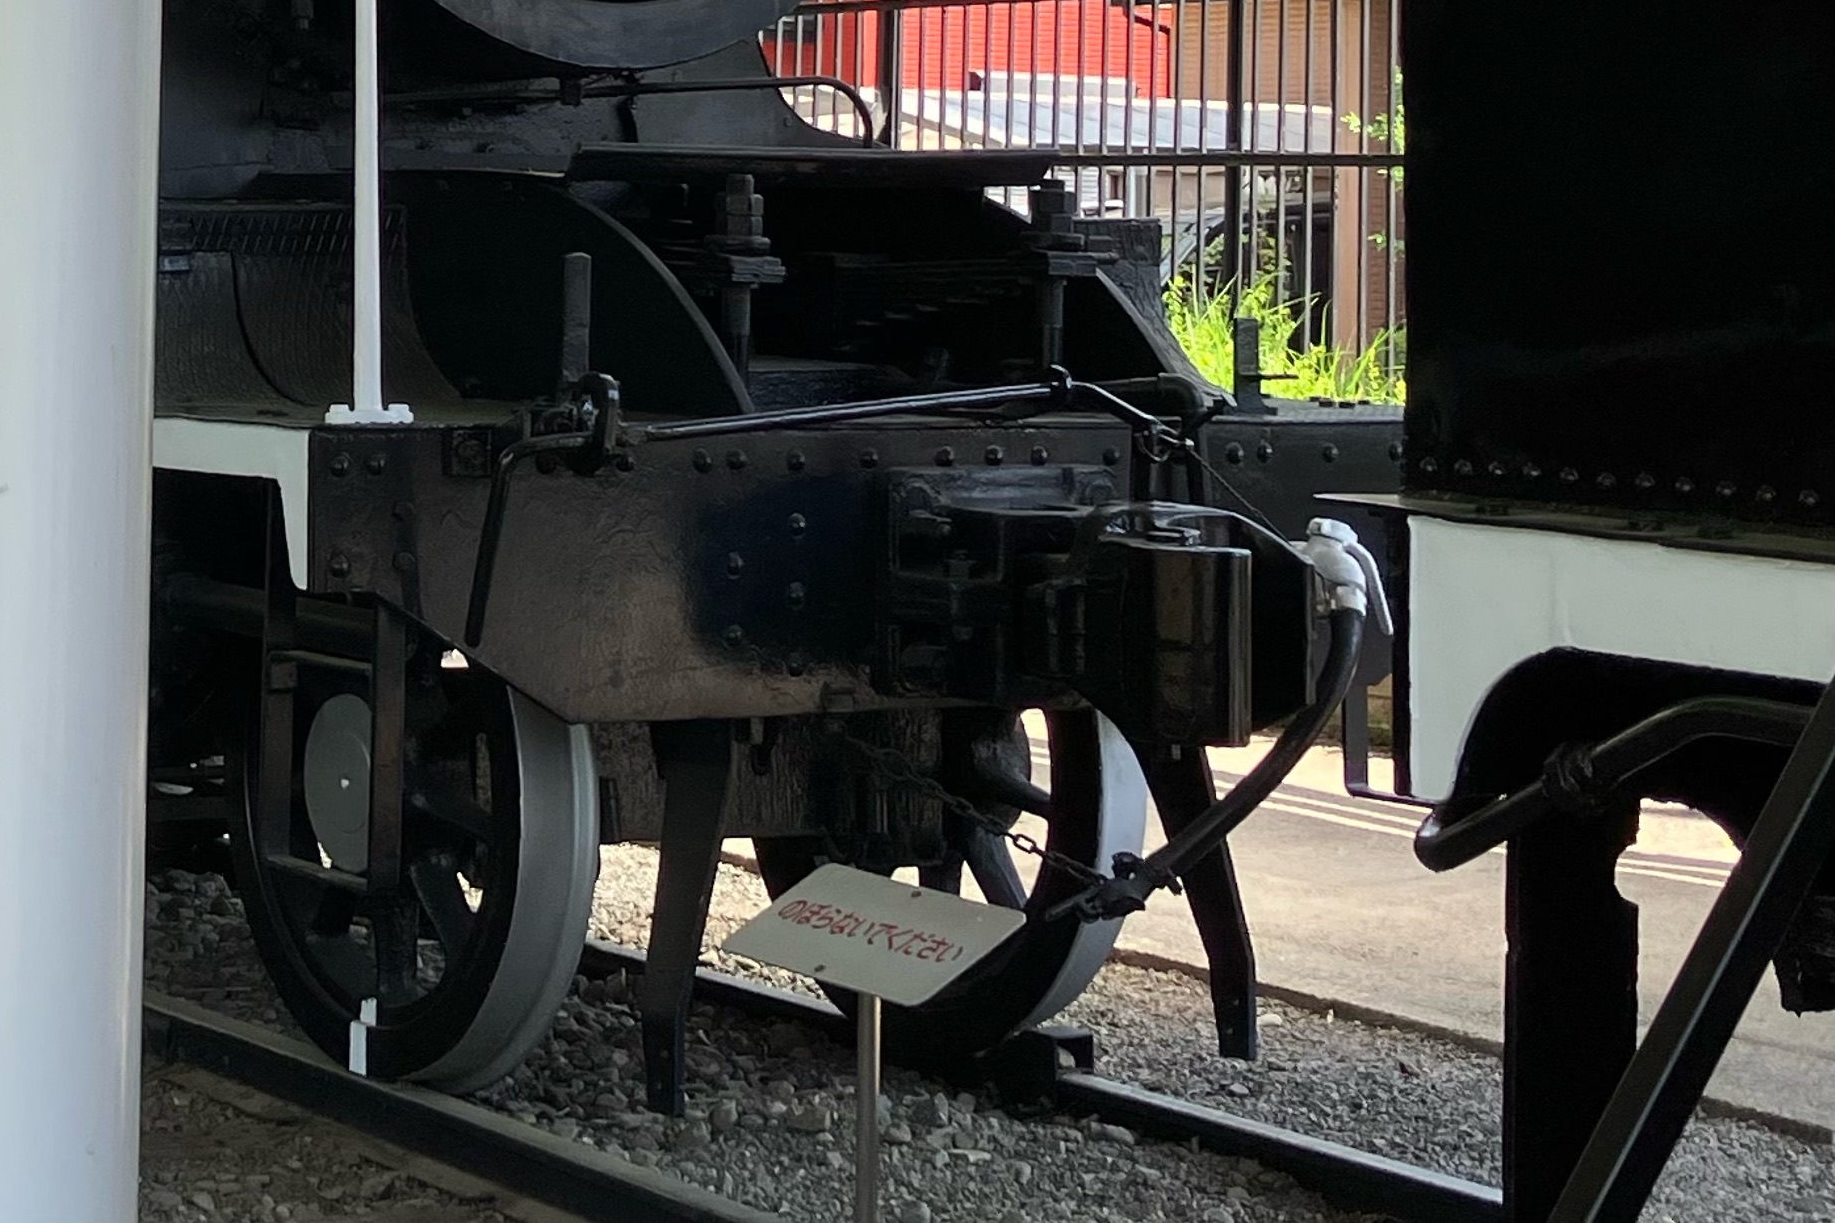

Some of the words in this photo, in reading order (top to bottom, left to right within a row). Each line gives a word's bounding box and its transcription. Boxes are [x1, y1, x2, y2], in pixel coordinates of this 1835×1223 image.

[778, 899, 963, 963] のぼらないでください
